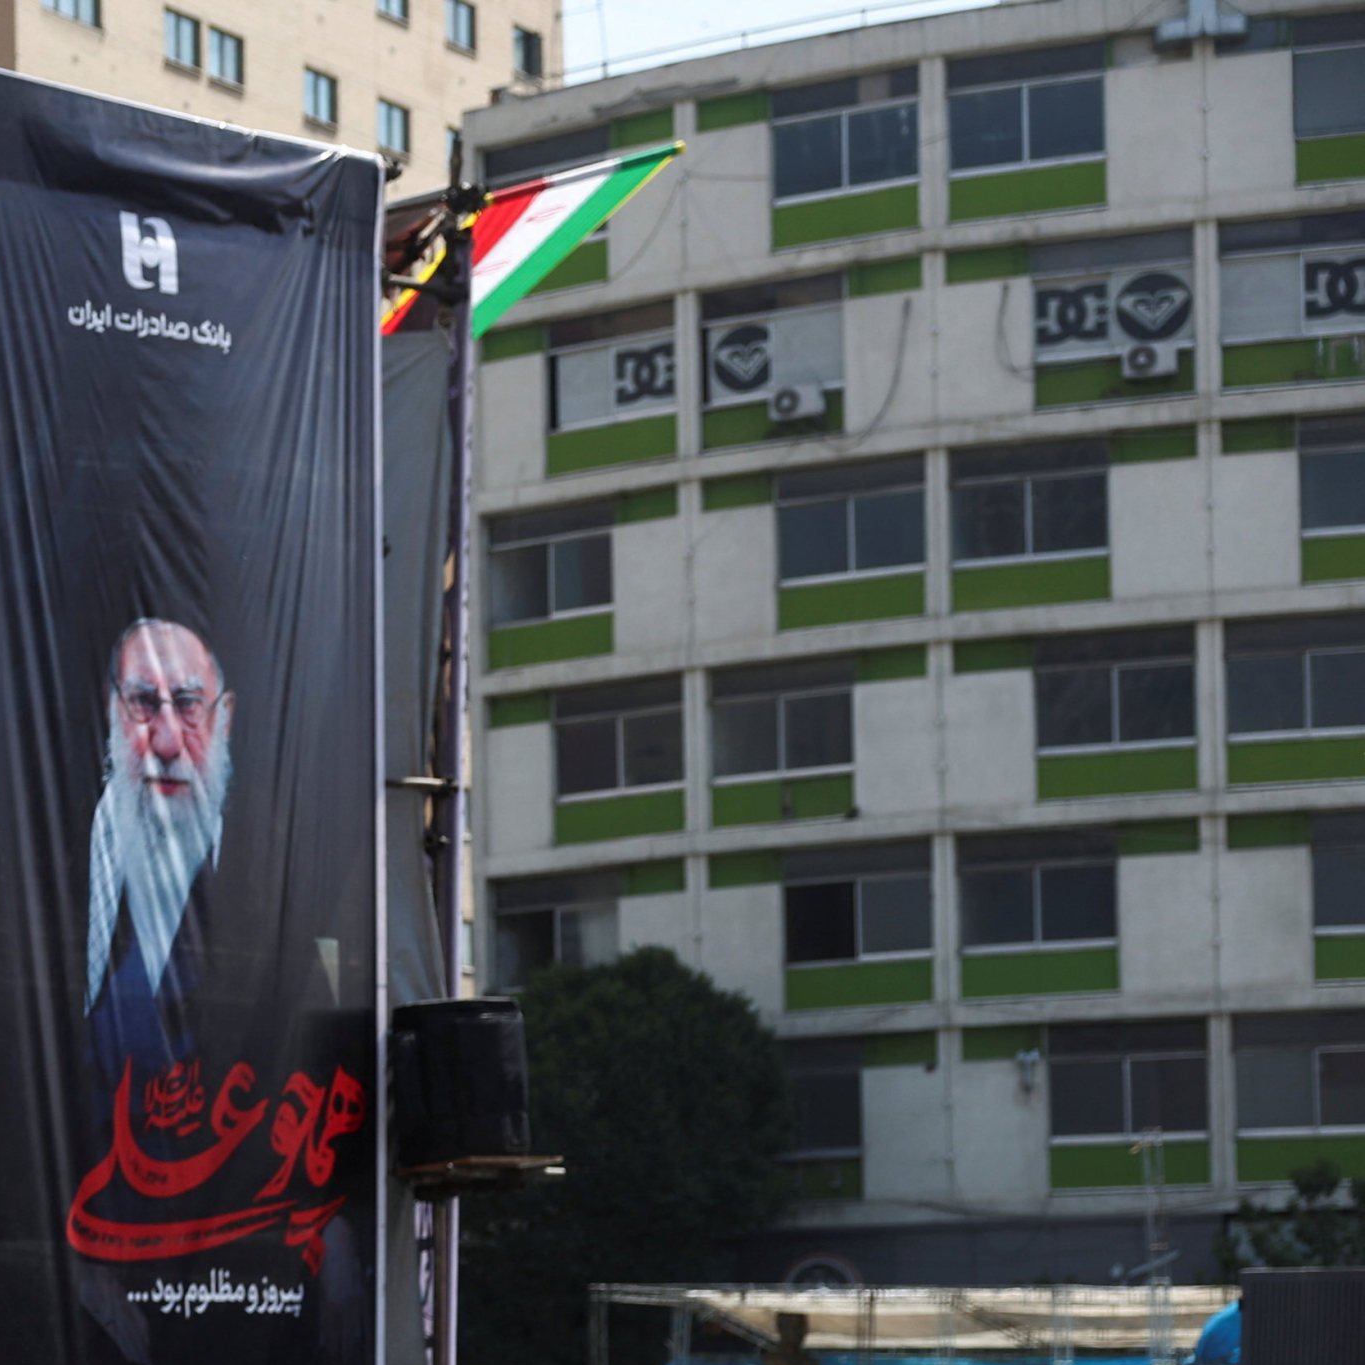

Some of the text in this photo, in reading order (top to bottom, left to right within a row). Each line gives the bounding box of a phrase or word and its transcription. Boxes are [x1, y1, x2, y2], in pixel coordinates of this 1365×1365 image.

[68, 299, 232, 355] بانک صادرات ایران
[184, 1267, 246, 1320] مظلوم
[244, 1282, 259, 1315] و
[258, 1276, 304, 1318] پیروز
